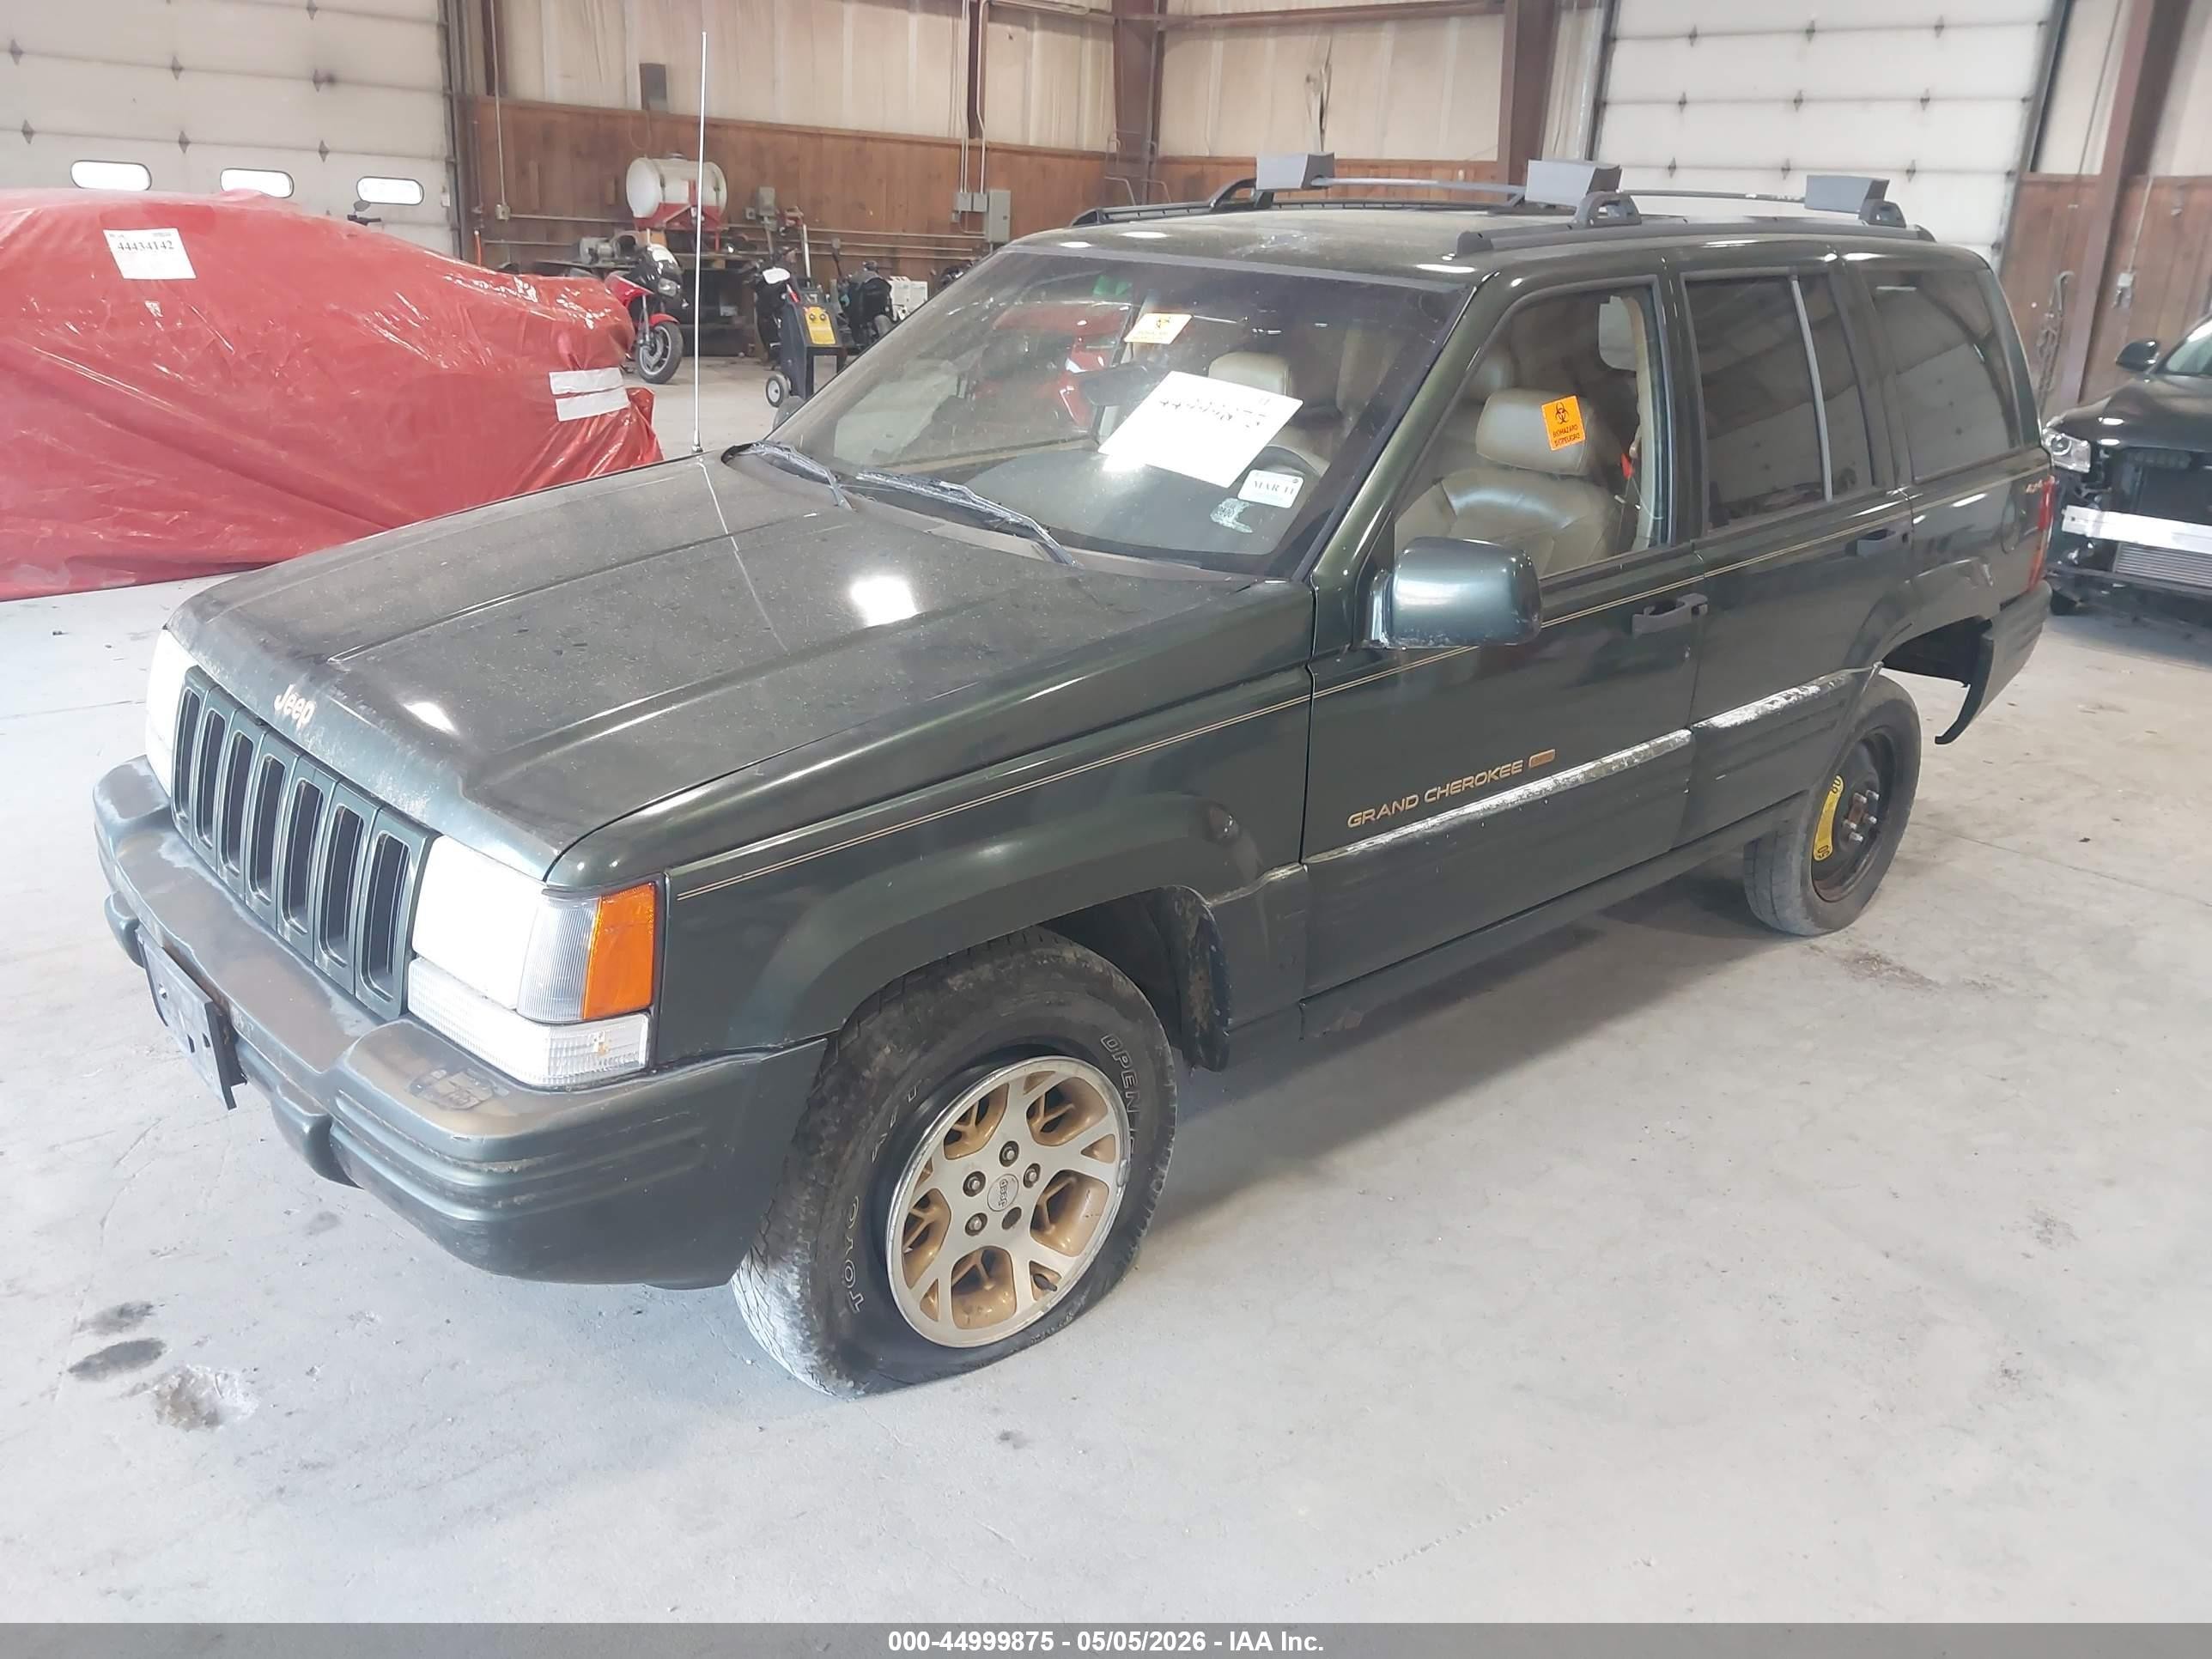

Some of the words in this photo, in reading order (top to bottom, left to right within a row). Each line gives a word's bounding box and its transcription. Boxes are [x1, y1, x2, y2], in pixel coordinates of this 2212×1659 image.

[274, 684, 317, 729] Jeep
[1346, 793, 1419, 828] GRAND
[1424, 759, 1523, 803] CHEROKEE
[1100, 1033, 1141, 1114] OPEN
